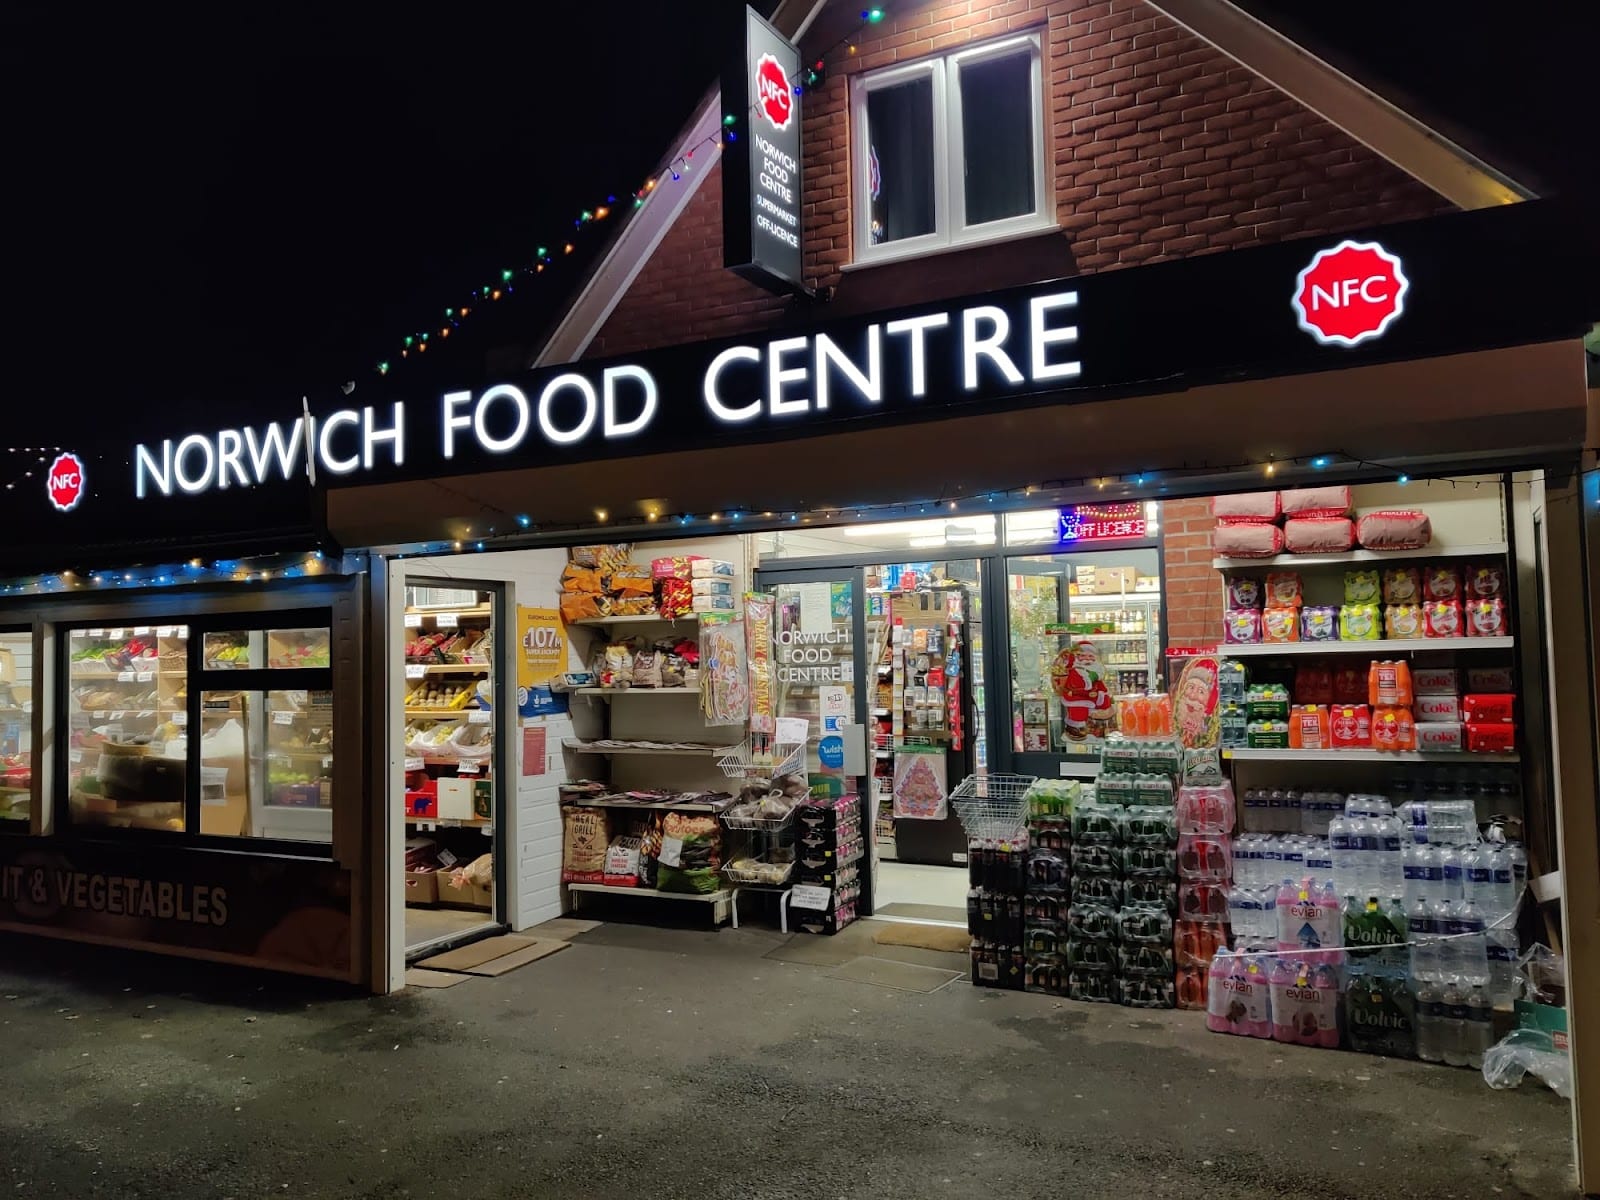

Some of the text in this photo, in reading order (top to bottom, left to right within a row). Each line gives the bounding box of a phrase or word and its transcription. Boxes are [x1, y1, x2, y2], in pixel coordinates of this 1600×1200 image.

[761, 73, 789, 110] NFC
[755, 134, 797, 174] NORWICH
[763, 157, 789, 184] FOOD
[759, 173, 792, 204] CENTRE
[756, 194, 797, 227] SUPERMARKET
[756, 214, 799, 248] OFF-LICENCE
[1312, 275, 1388, 311] NFC
[136, 291, 1082, 499] NORWICH FOOD CENTRE
[52, 472, 79, 490] NFC
[1074, 519, 1144, 536] OFF LICENCE
[771, 629, 849, 645] NORWICH
[783, 648, 832, 663] FOOD
[777, 667, 840, 682] CENTRE
[1417, 675, 1450, 687] Coke
[1421, 702, 1454, 714] Coke
[1423, 731, 1457, 743] Coke
[575, 815, 595, 825] REAL
[574, 824, 594, 836] GRILL
[31, 867, 48, 904] &
[56, 870, 230, 928] VEGETABLES
[1291, 905, 1323, 921] evian
[1347, 925, 1402, 946] Volvic
[1223, 979, 1253, 998] evian
[1286, 988, 1321, 1003] evian
[1353, 1007, 1407, 1030] Volvic
